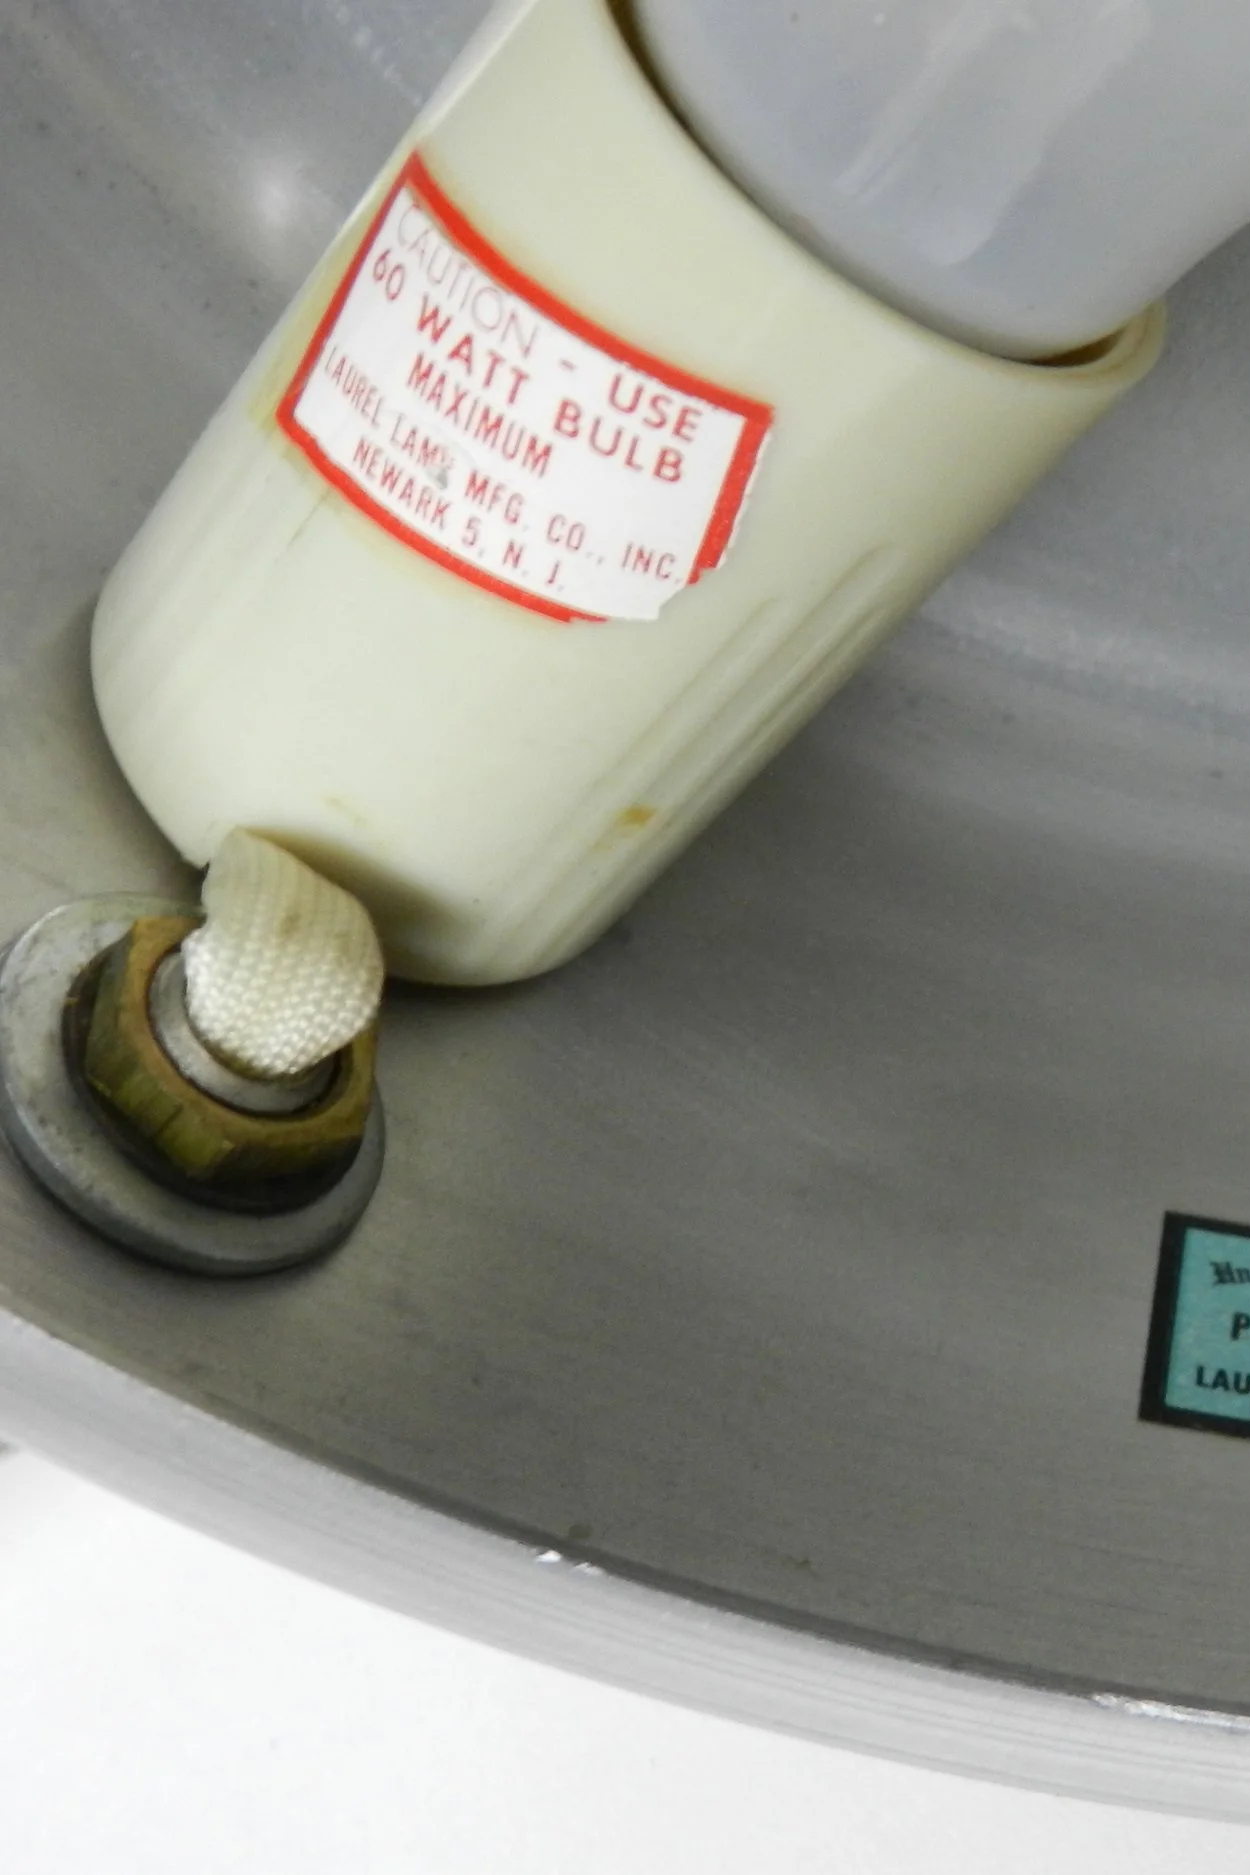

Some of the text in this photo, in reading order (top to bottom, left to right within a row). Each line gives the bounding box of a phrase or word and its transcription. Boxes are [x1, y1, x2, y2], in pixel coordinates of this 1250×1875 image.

[371, 248, 685, 485] 60 WATT BULB
[396, 203, 539, 359] CAUTION
[607, 371, 703, 445] USE
[404, 351, 553, 480] MAXIMUM
[323, 344, 385, 429] LAUREL
[463, 468, 530, 532] MFG.
[544, 513, 606, 566] CO.,
[620, 541, 683, 585] INC.
[351, 436, 448, 531] NEWARK
[501, 539, 530, 577] N.
[544, 558, 566, 592] J.
